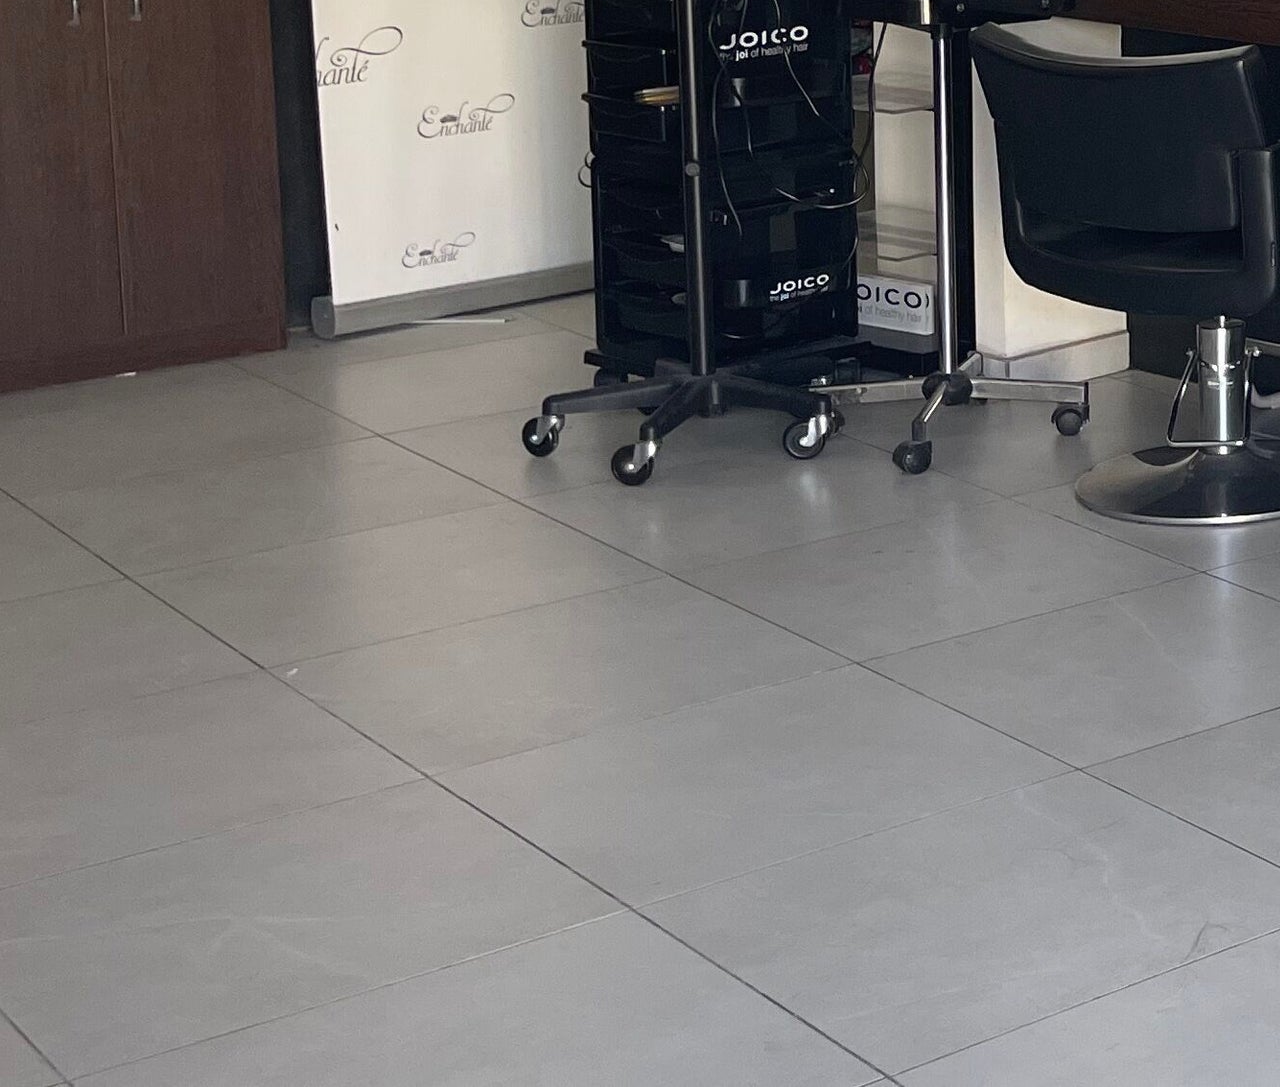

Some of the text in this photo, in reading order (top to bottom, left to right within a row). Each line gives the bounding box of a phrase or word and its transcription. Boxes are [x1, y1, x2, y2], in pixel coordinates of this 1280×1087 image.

[720, 26, 808, 50] JOICO
[770, 274, 829, 294] JOICO
[856, 284, 921, 308] OICO
